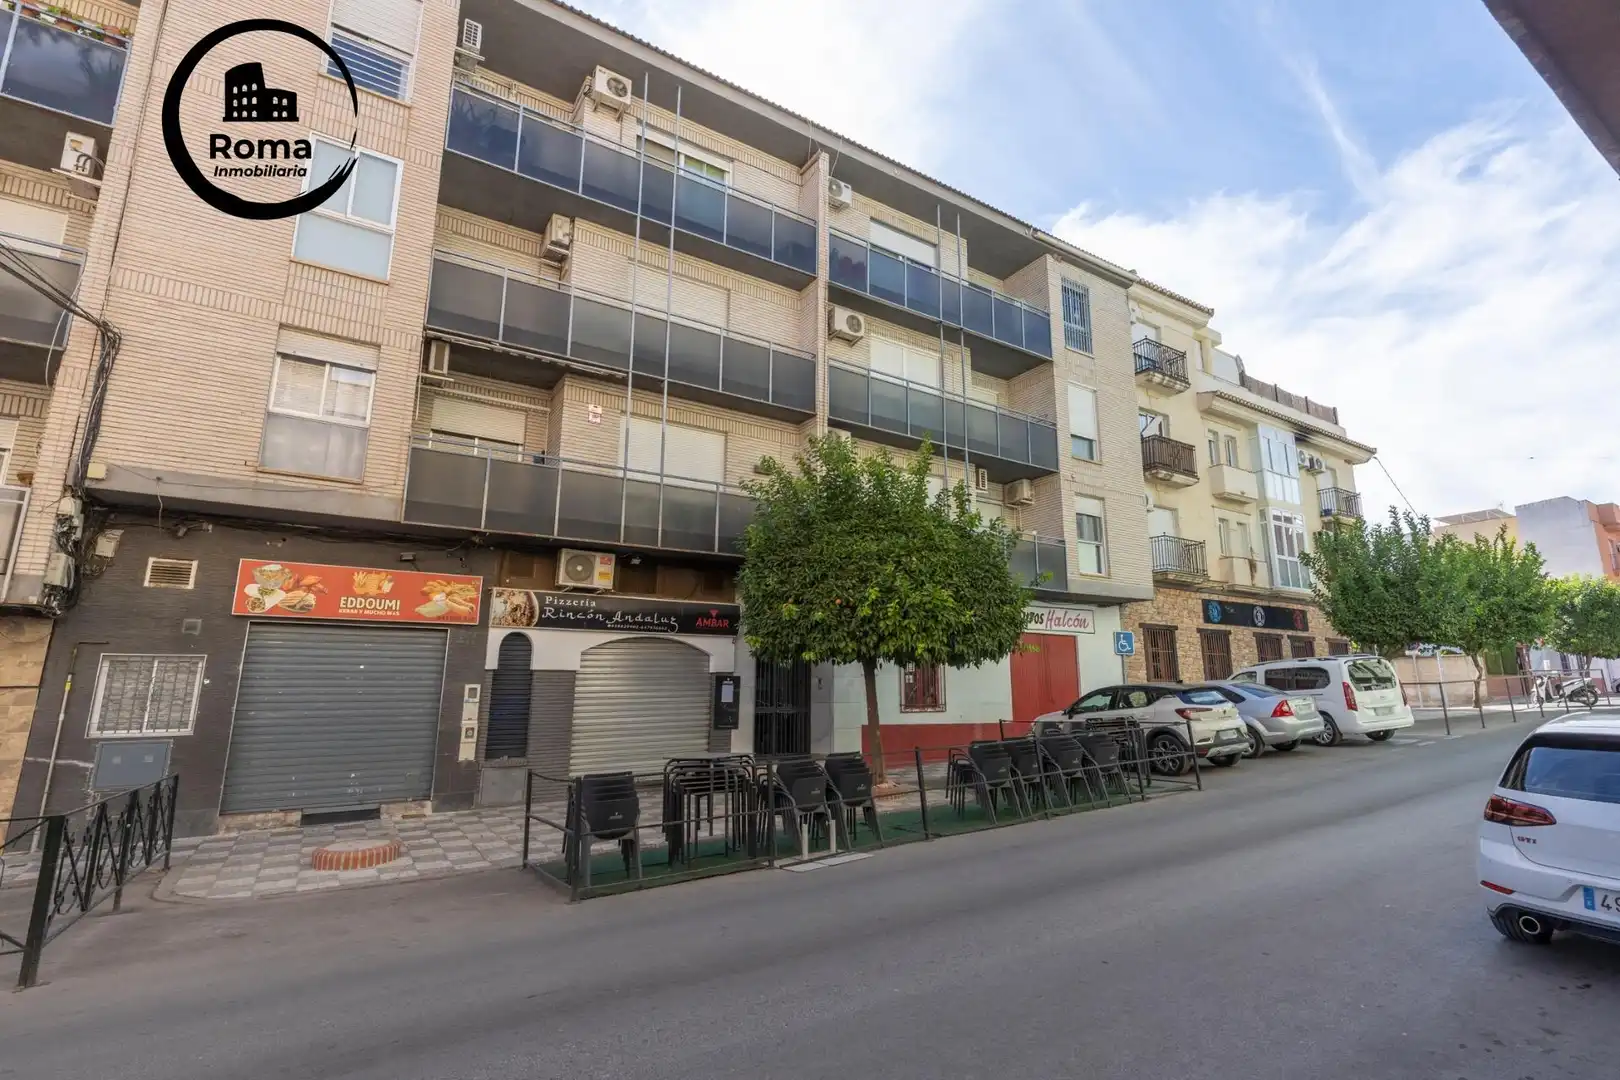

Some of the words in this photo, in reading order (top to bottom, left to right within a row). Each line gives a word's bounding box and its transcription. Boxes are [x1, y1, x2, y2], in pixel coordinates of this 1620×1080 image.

[340, 597, 401, 610] EDDOUMI
[542, 607, 606, 621] Rincón
[606, 611, 679, 633] Andaluz
[695, 616, 729, 628] AMBAR
[1045, 609, 1090, 630] Halcón
[1517, 836, 1537, 844] GTI
